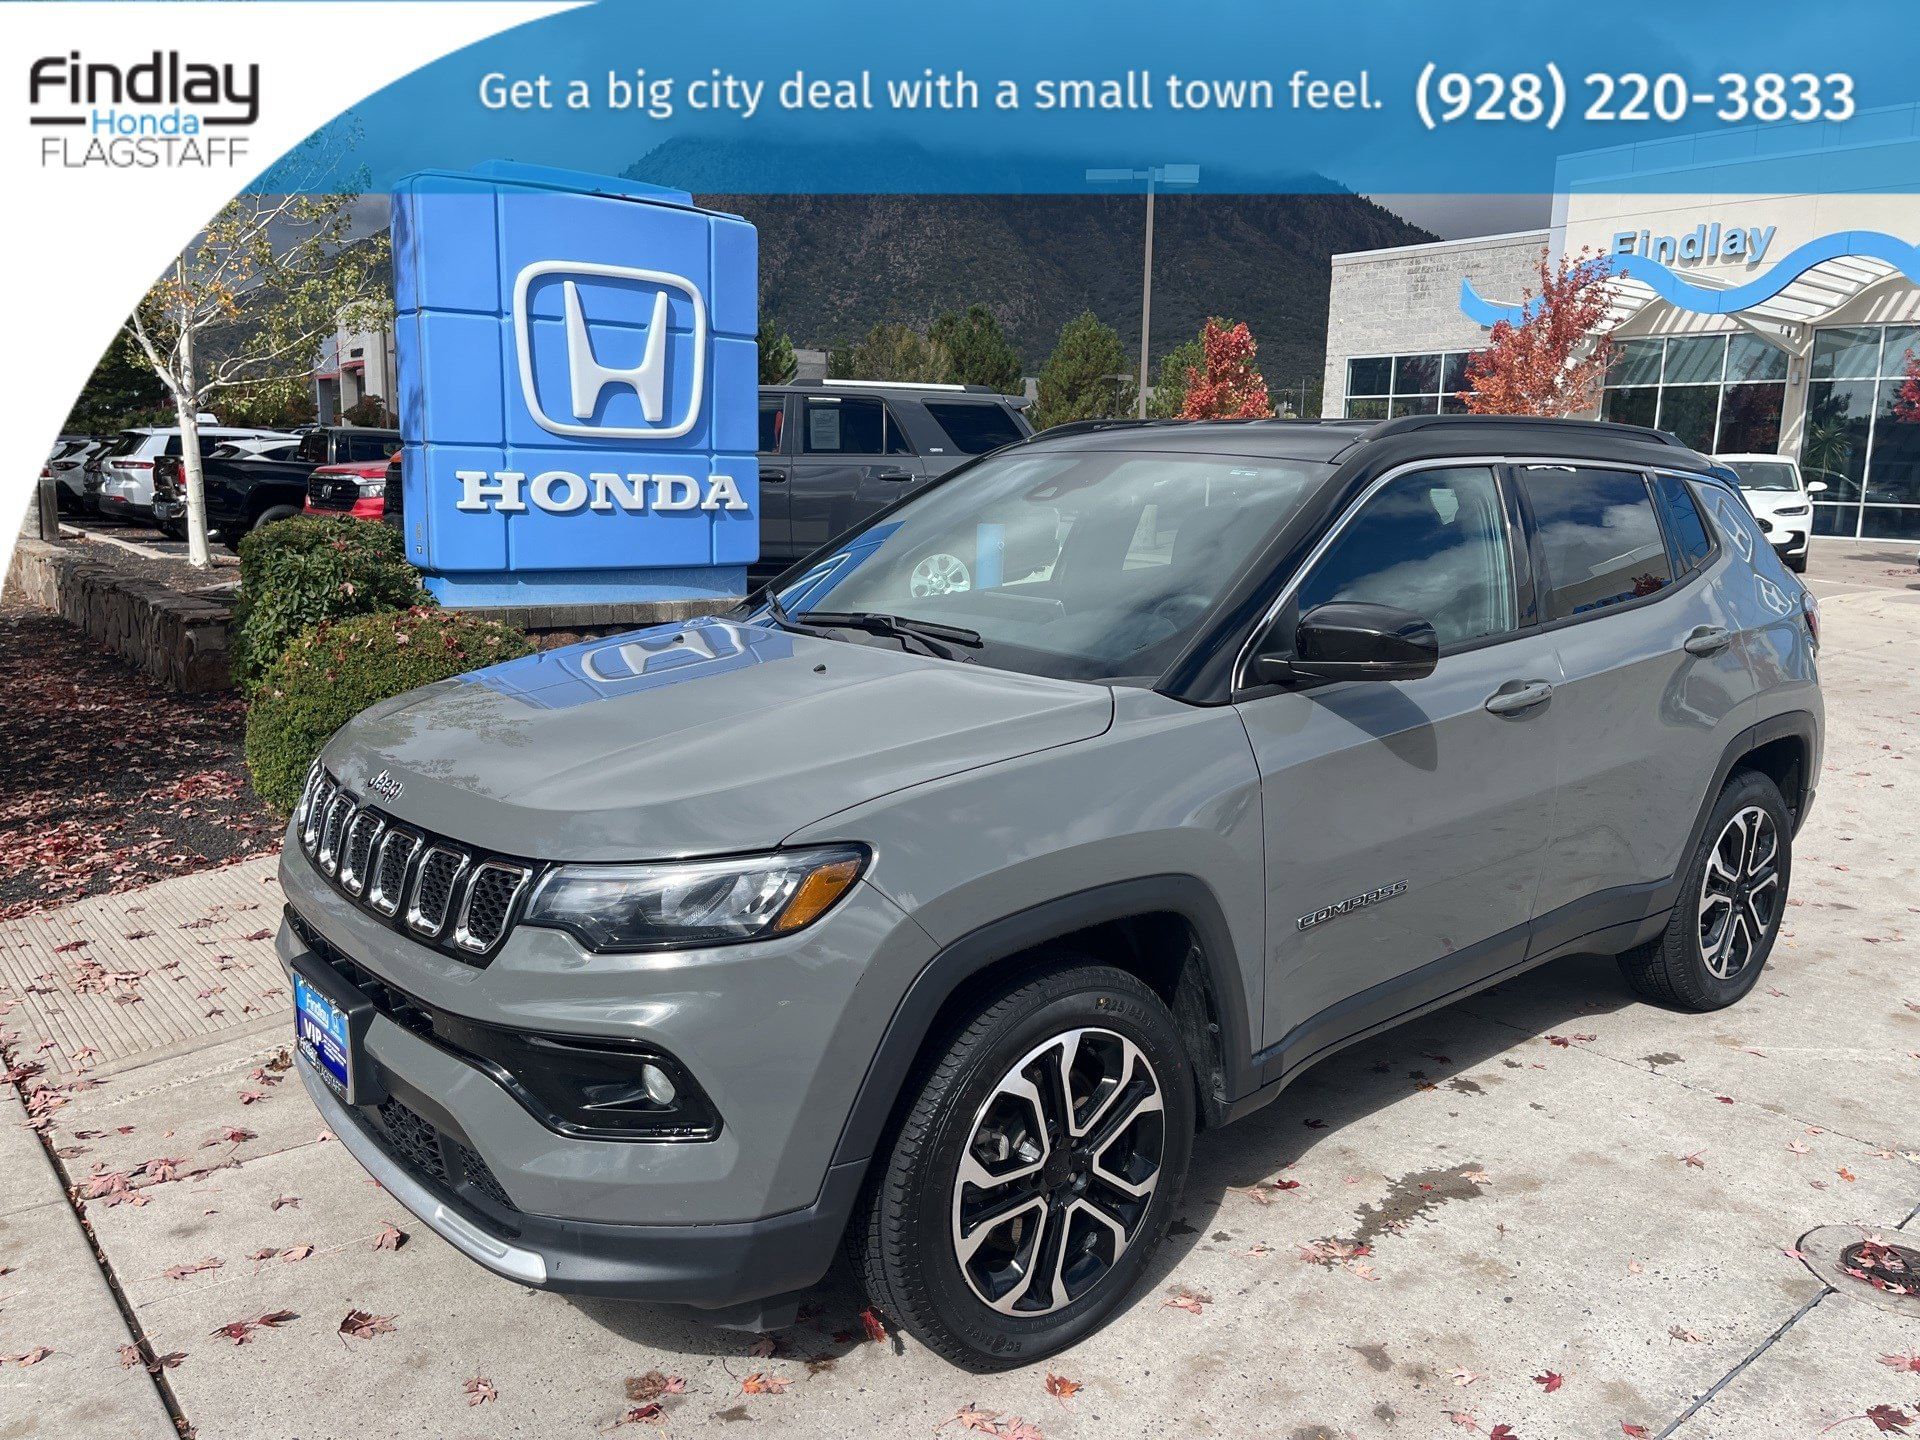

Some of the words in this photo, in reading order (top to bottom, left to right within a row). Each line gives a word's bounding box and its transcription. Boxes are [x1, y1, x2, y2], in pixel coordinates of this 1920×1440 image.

[1611, 221, 1778, 264] Findlay
[454, 470, 749, 512] HONDA
[367, 769, 404, 804] Jeep
[1297, 879, 1409, 931] COMPASS
[303, 1017, 322, 1046] VIP
